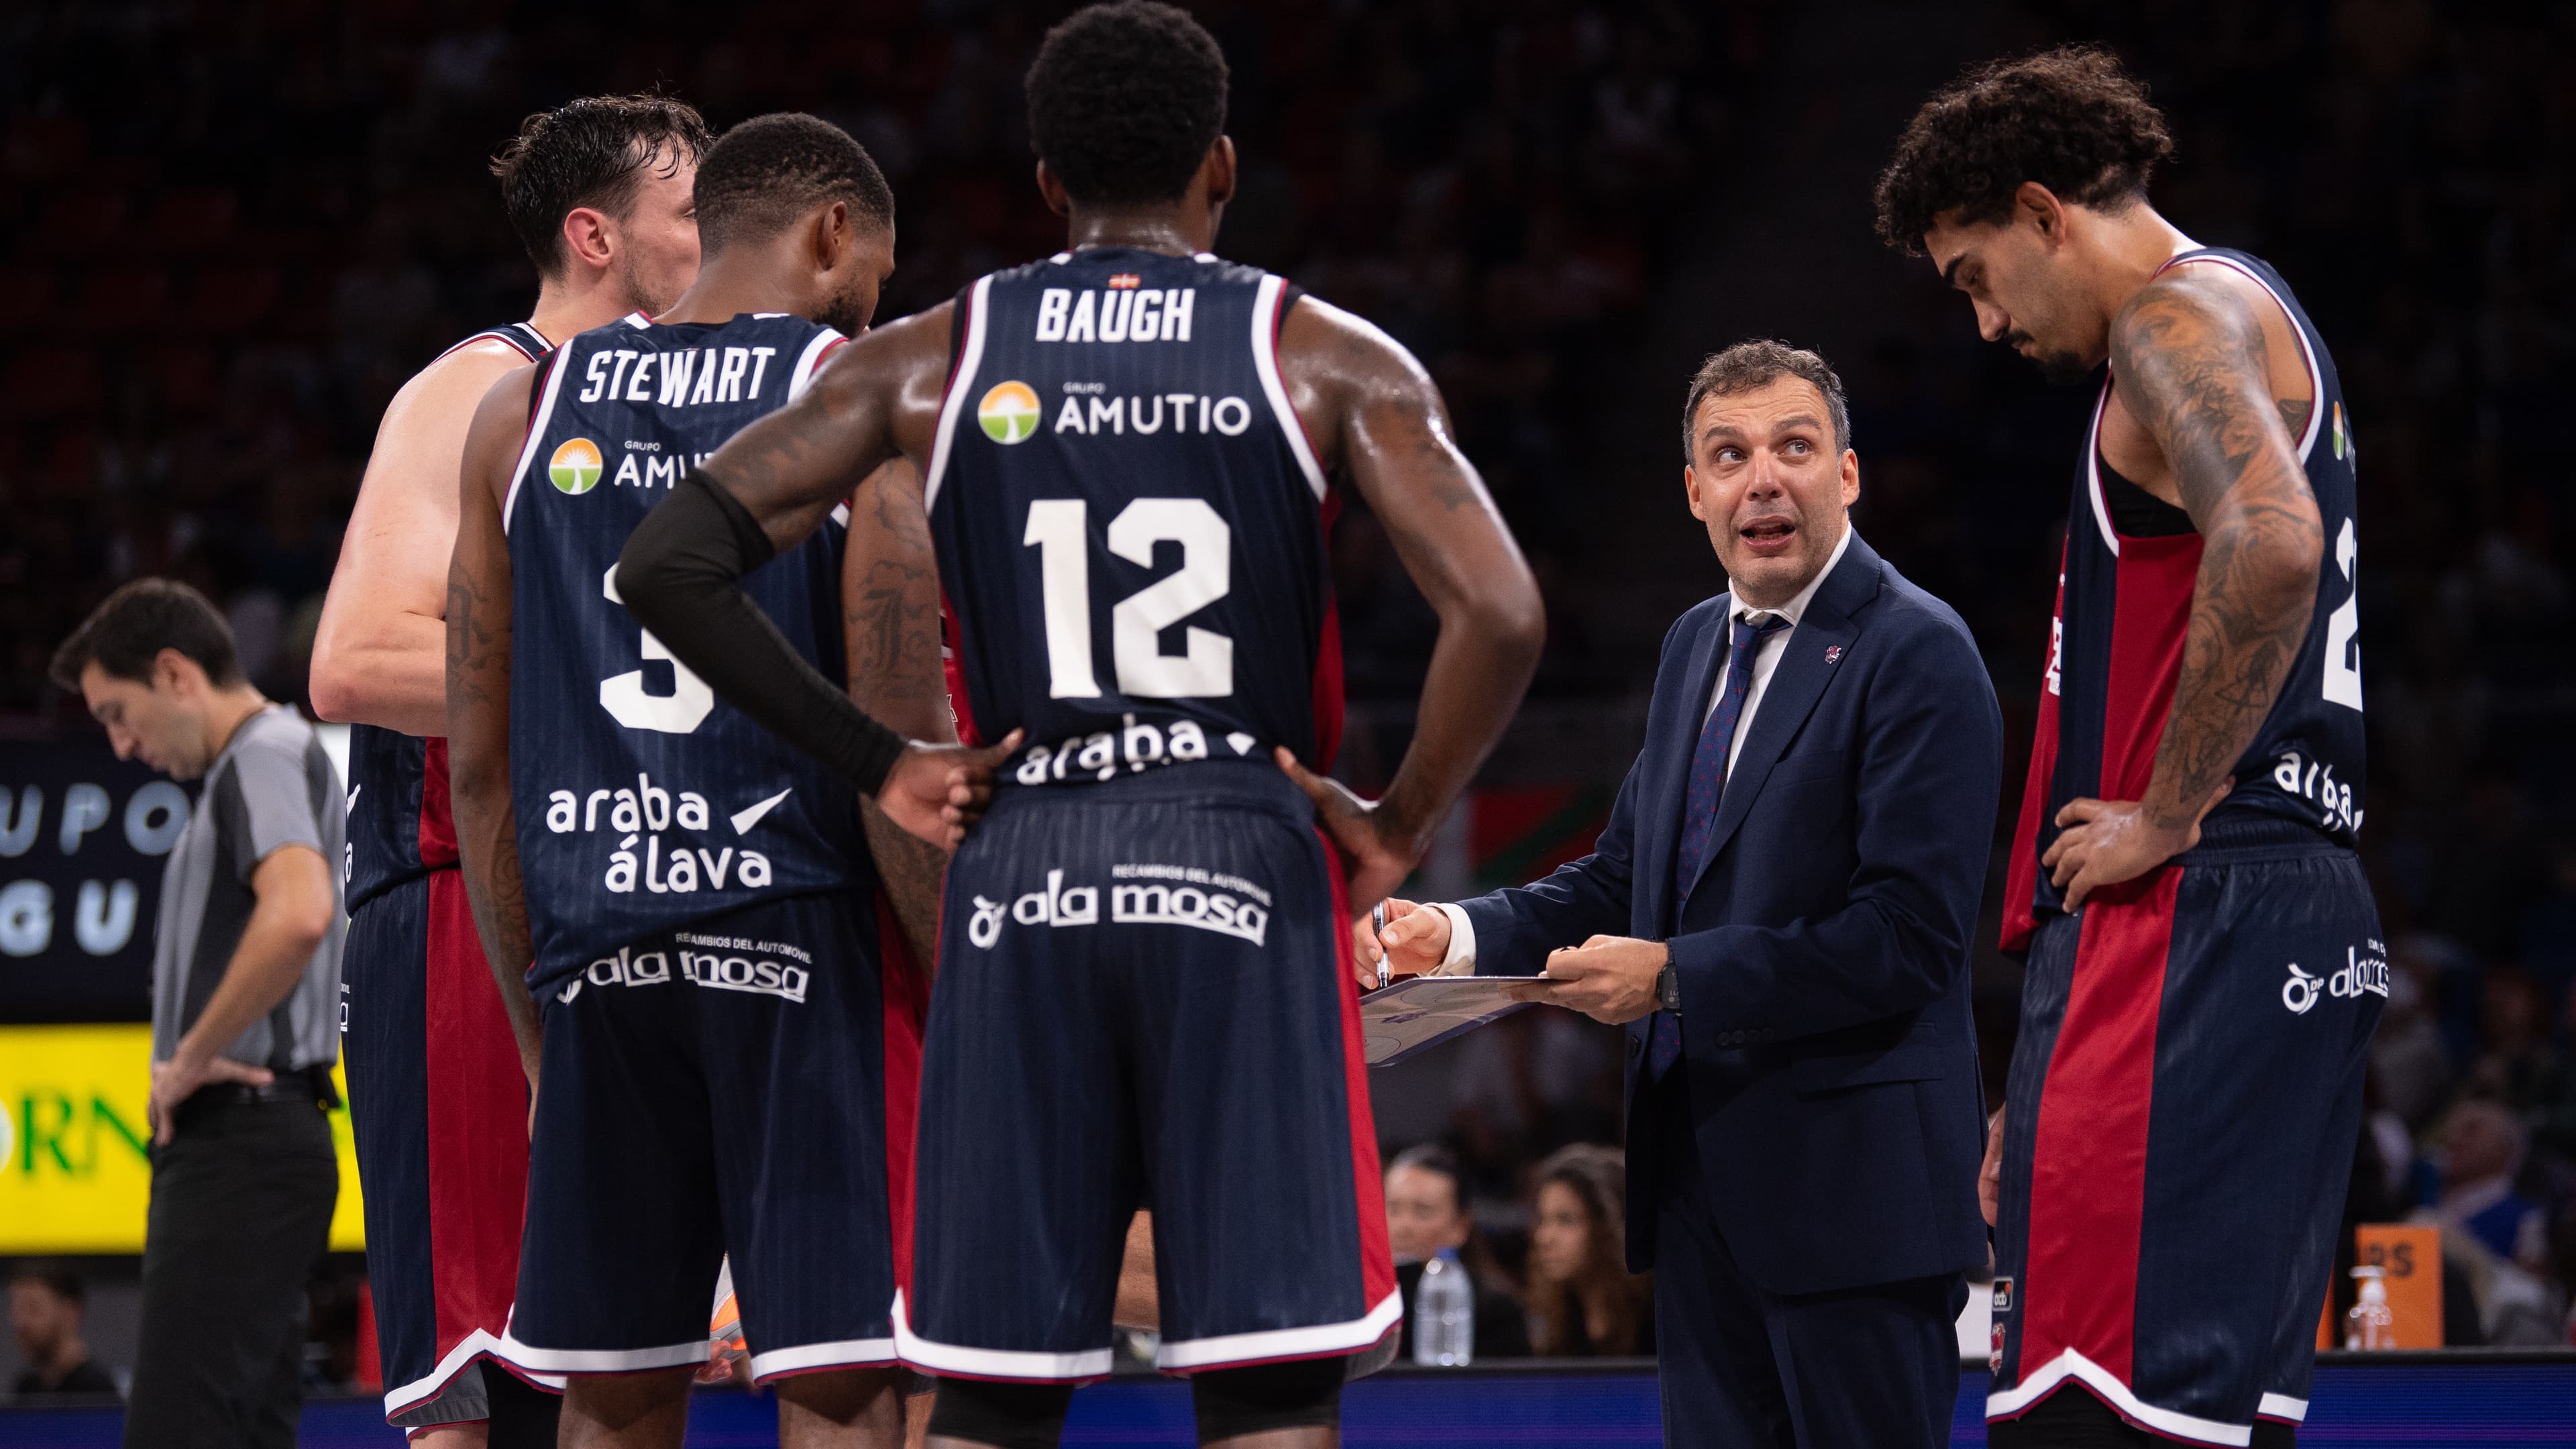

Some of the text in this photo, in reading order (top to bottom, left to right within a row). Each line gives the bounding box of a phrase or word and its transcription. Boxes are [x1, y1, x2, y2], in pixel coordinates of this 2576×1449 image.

[1036, 288, 1195, 342] BAUGH
[579, 347, 776, 408] STEWART
[1063, 382, 1106, 394] GRUPO
[1055, 393, 1252, 436] AMUTIO
[625, 440, 661, 451] GRUPO
[1023, 497, 1234, 700] 12
[545, 772, 710, 834] araba
[604, 834, 772, 894] álava
[1185, 867, 1210, 884] DEL
[1112, 884, 1268, 947] mosa
[733, 938, 754, 951] DEL
